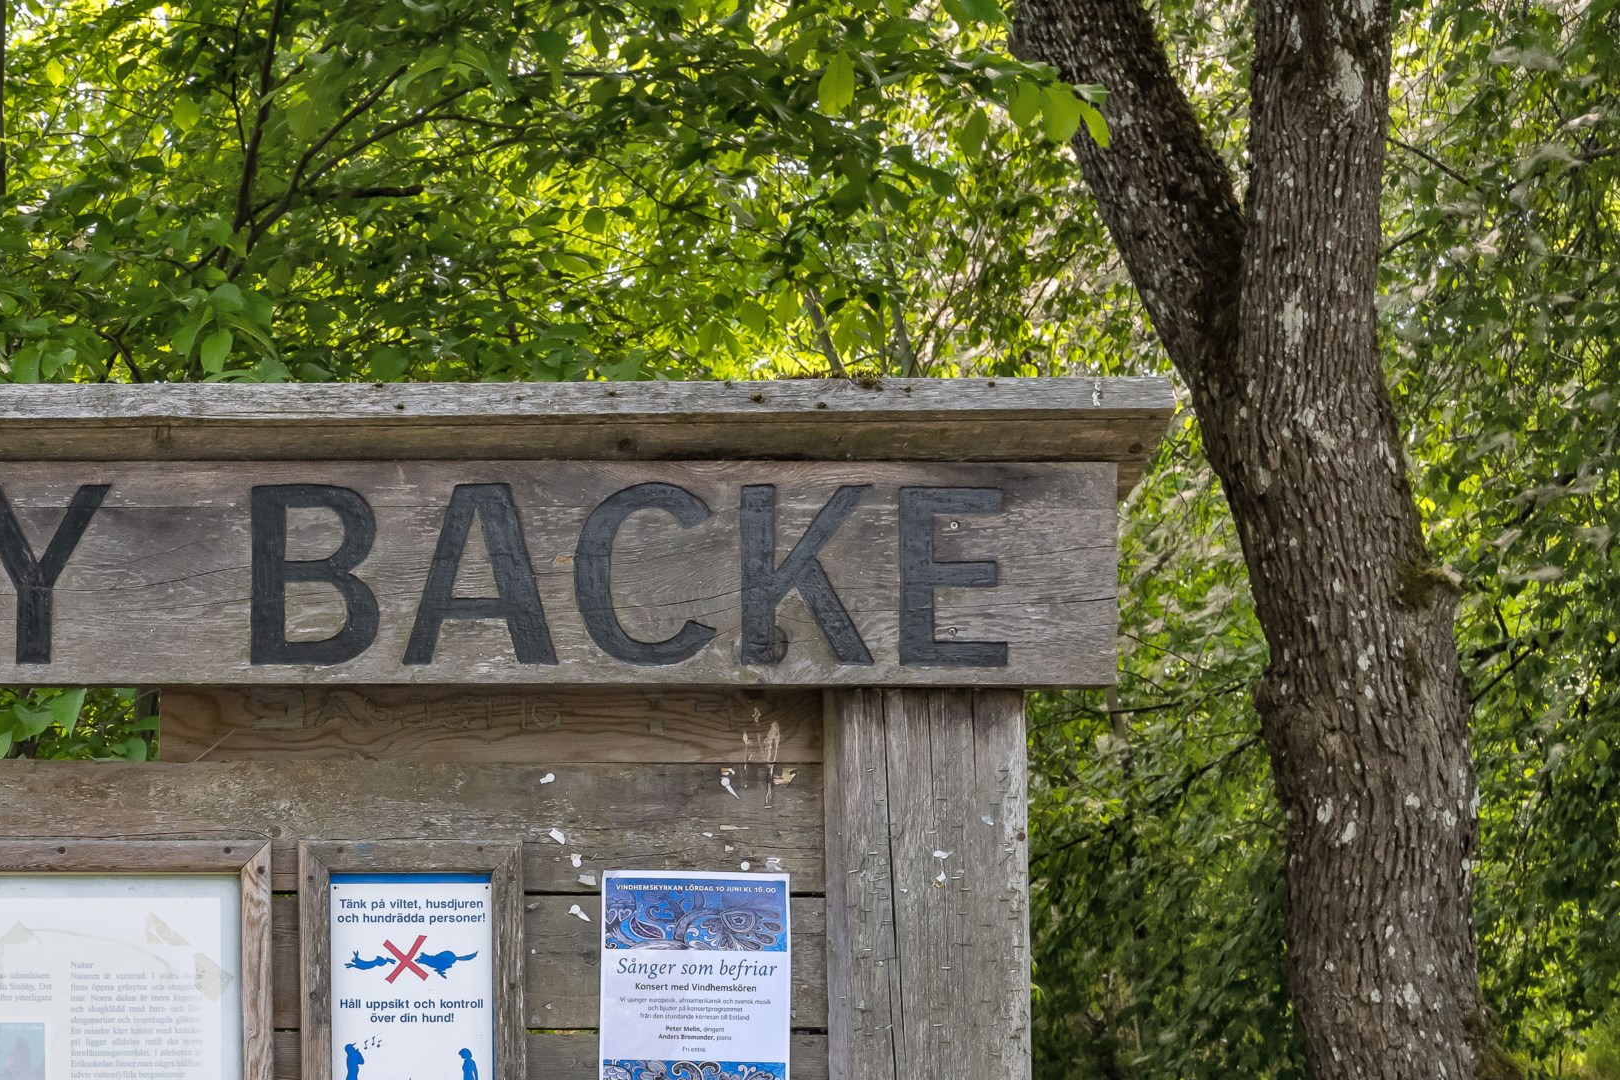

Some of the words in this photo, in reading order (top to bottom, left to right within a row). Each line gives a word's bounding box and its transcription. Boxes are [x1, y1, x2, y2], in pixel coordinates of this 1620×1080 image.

[250, 481, 1009, 668] BACKE
[684, 884, 714, 893] LÖRDAG
[339, 898, 367, 910] Tänk
[370, 898, 385, 912] på
[389, 898, 422, 912] viltet,
[425, 898, 484, 912] husdjuren
[336, 912, 359, 924] och
[362, 912, 425, 924] hundrädda
[428, 912, 486, 926] personer!
[616, 958, 676, 980] Sånger
[680, 965, 714, 976] som
[719, 960, 778, 980] befriar
[635, 983, 668, 991] Konsert
[670, 983, 689, 992] med
[692, 983, 757, 992] Vindhemskören
[340, 998, 362, 1009] Håll
[365, 998, 409, 1012] uppsikt
[413, 998, 435, 1009] och
[439, 998, 484, 1009] kontroll
[626, 996, 647, 1005] sjunger
[659, 1005, 677, 1014] bjuder
[678, 1005, 686, 1014] på
[686, 1006, 743, 1014] konsertprogrammet
[370, 1012, 396, 1023] över
[399, 1012, 417, 1023] din
[421, 1012, 454, 1023] hund!
[702, 1026, 725, 1034] dirigent
[680, 1033, 715, 1042] Bromander,
[716, 1034, 732, 1042] piano
